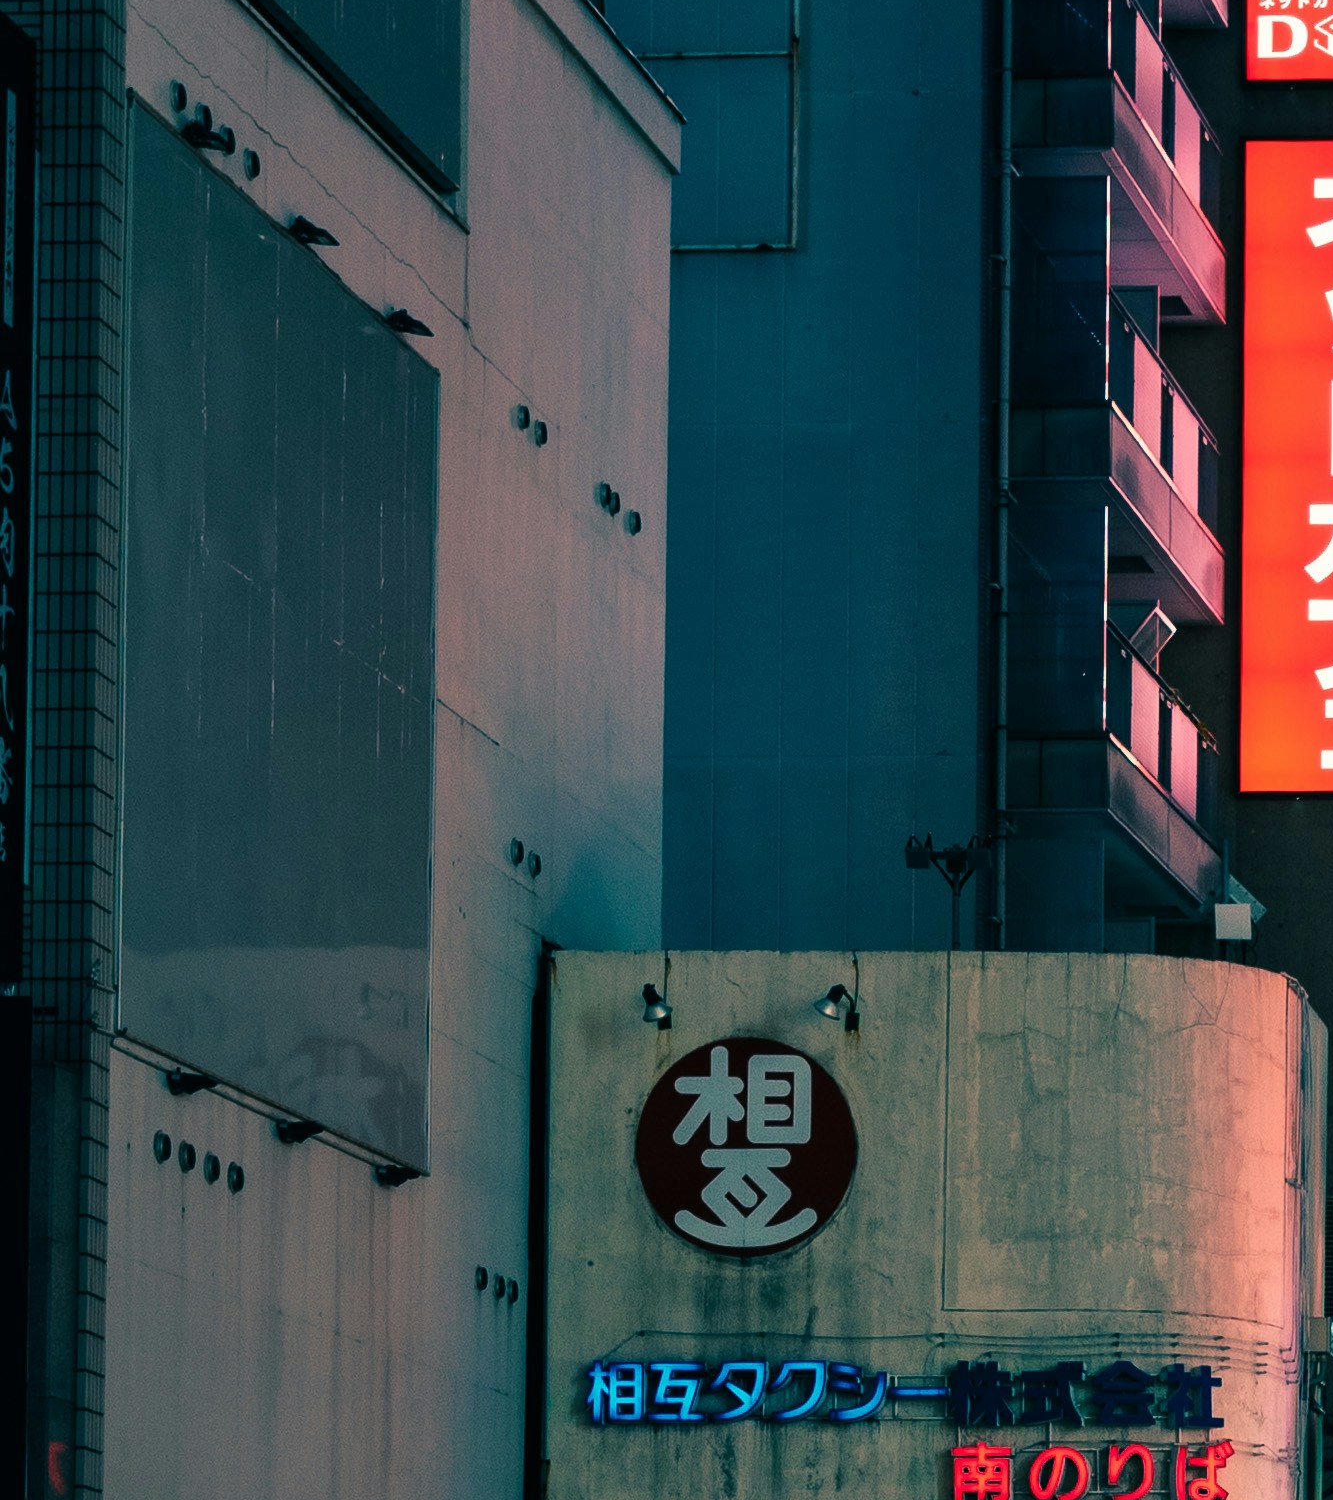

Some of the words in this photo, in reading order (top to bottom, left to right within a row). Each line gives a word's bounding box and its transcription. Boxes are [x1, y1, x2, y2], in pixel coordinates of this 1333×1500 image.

[585, 1357, 1227, 1430] 相互タクシー株式会社
